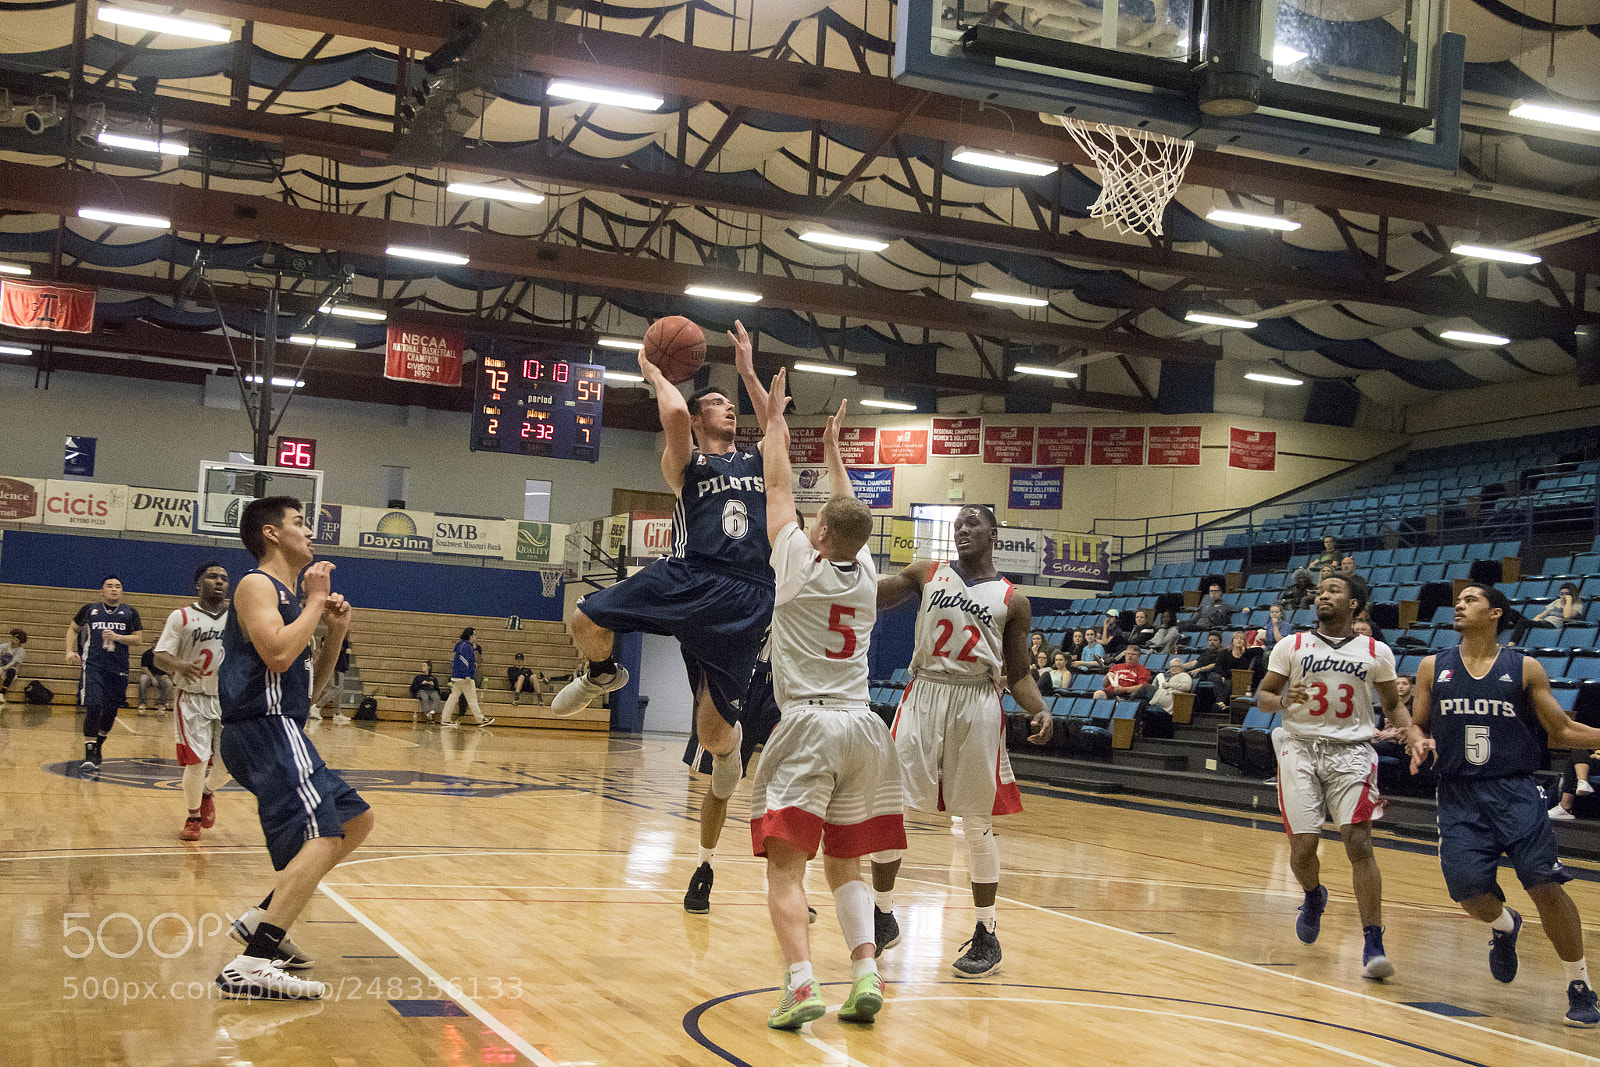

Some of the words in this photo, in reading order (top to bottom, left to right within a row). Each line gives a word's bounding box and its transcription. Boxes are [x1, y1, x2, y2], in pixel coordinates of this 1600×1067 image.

[402, 332, 446, 349] NBCAA
[393, 342, 420, 354] NATIONAL
[422, 346, 456, 358] BASKETBALL
[407, 353, 439, 364] CHAMPION
[407, 362, 434, 372] DIVISION
[484, 356, 505, 368] Home
[486, 370, 508, 392] 72
[577, 380, 601, 401] 54
[528, 396, 552, 405] period
[483, 405, 500, 415] fouls
[527, 409, 550, 420] player
[488, 419, 499, 434] 2
[576, 415, 593, 424] fouls
[521, 422, 554, 440] 2-32
[582, 428, 590, 443] 7
[280, 441, 311, 467] 26
[697, 474, 764, 497] PILOTS
[47, 492, 108, 516] cicis
[133, 493, 196, 512] DRUR
[154, 512, 192, 528] INN
[722, 499, 748, 539] 6
[436, 523, 477, 540] SMB
[611, 524, 625, 536] BEST
[644, 522, 671, 548] GLO
[364, 534, 401, 548] Days
[403, 537, 428, 549] Inn
[436, 539, 462, 548] Southwest
[464, 541, 486, 549] Missouri
[517, 545, 549, 555] QUALITY
[611, 537, 623, 548] BUY
[994, 538, 1036, 552] bank
[1053, 534, 1101, 563] TILT
[1053, 563, 1101, 575] Studio
[927, 589, 992, 628] Patriots
[92, 622, 126, 630] PILOTS
[825, 604, 856, 659] 5
[192, 627, 224, 647] Patri
[932, 619, 981, 663] 22
[1301, 654, 1367, 682] Patriots
[1309, 682, 1354, 719] 33
[1440, 698, 1516, 717] PILOTS
[1465, 725, 1490, 766] 5
